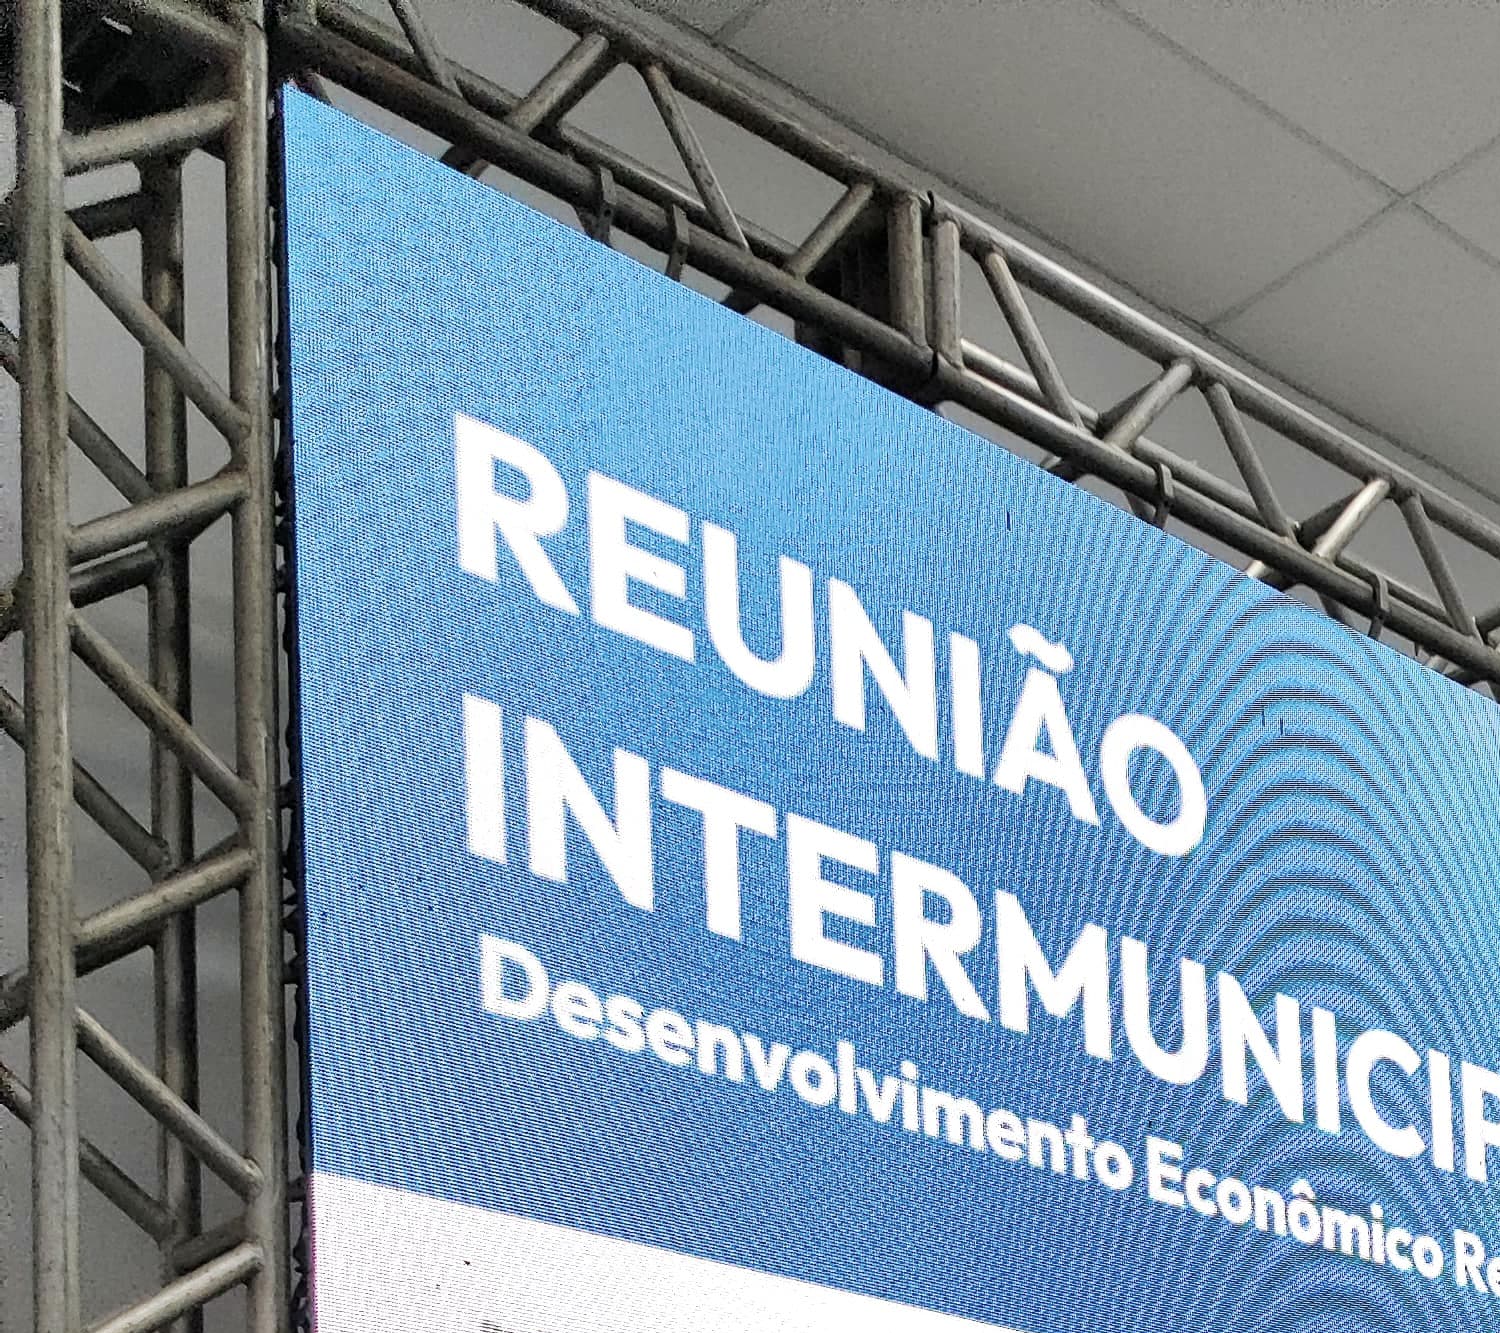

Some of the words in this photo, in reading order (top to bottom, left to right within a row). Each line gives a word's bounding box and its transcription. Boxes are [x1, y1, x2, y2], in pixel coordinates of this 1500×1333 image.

[455, 411, 1206, 857] REUNIÃO
[480, 933, 1133, 1190] Desenvolvimento
[1147, 1136, 1445, 1279] Econômico
